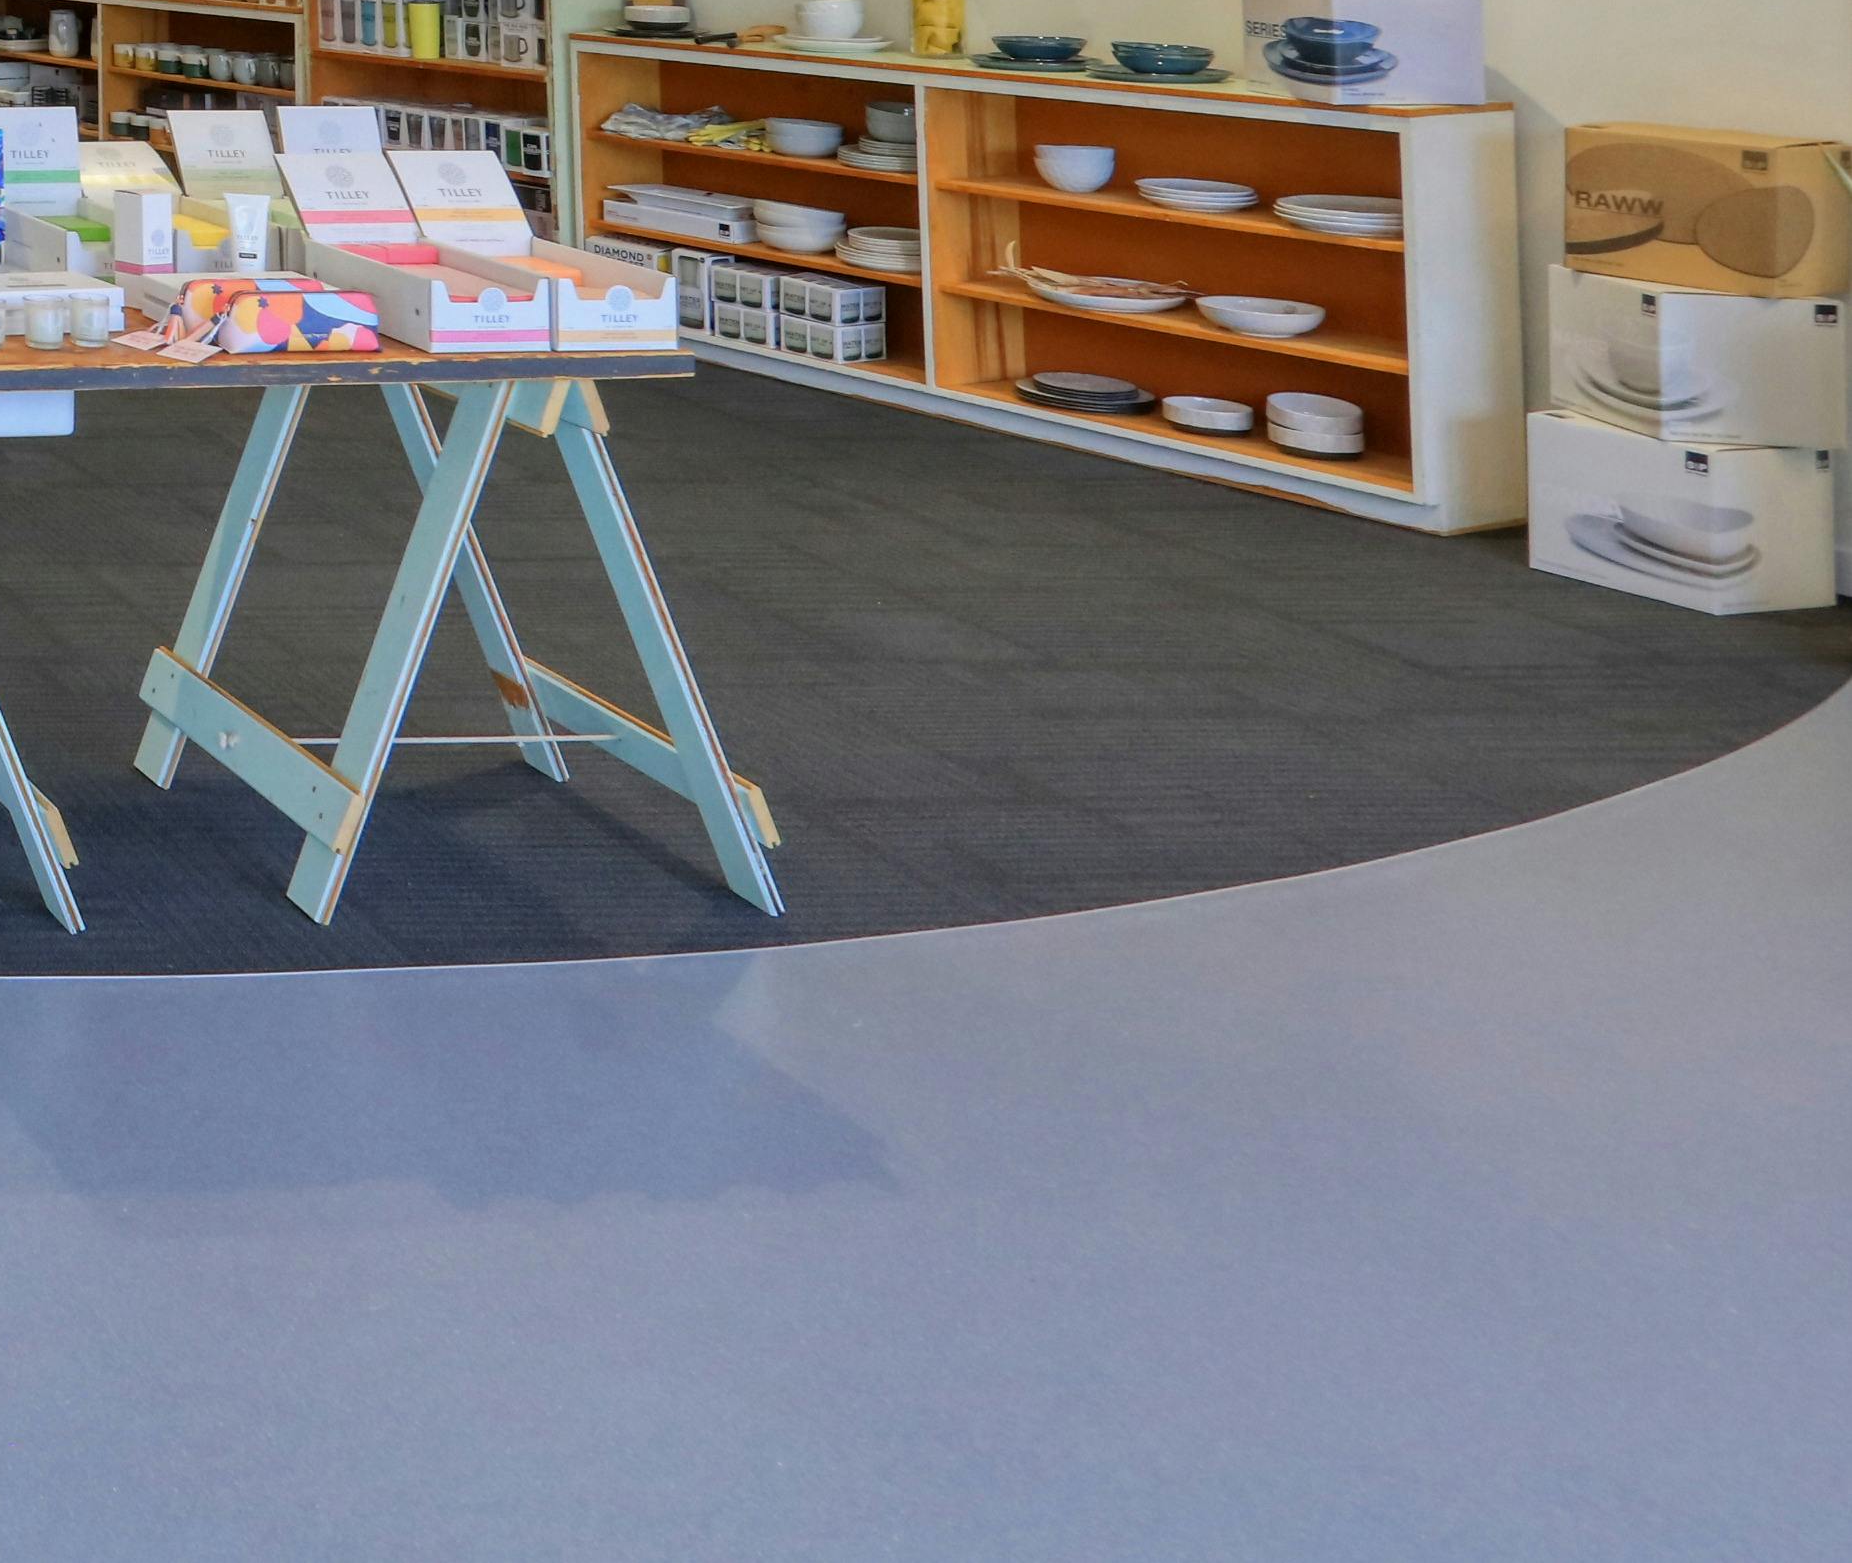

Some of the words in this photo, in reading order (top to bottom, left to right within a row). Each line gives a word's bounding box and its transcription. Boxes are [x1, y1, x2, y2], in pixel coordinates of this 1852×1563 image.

[1246, 20, 1288, 38] SERIES
[10, 149, 49, 159] TILLEY
[207, 149, 246, 159] TILLEY
[325, 190, 370, 200] TILLEY
[437, 188, 483, 198] TILLEY
[1574, 190, 1664, 216] RAWW
[594, 245, 644, 262] DIAMOND
[472, 315, 510, 324] TILLEY
[600, 314, 638, 323] TILLEY
